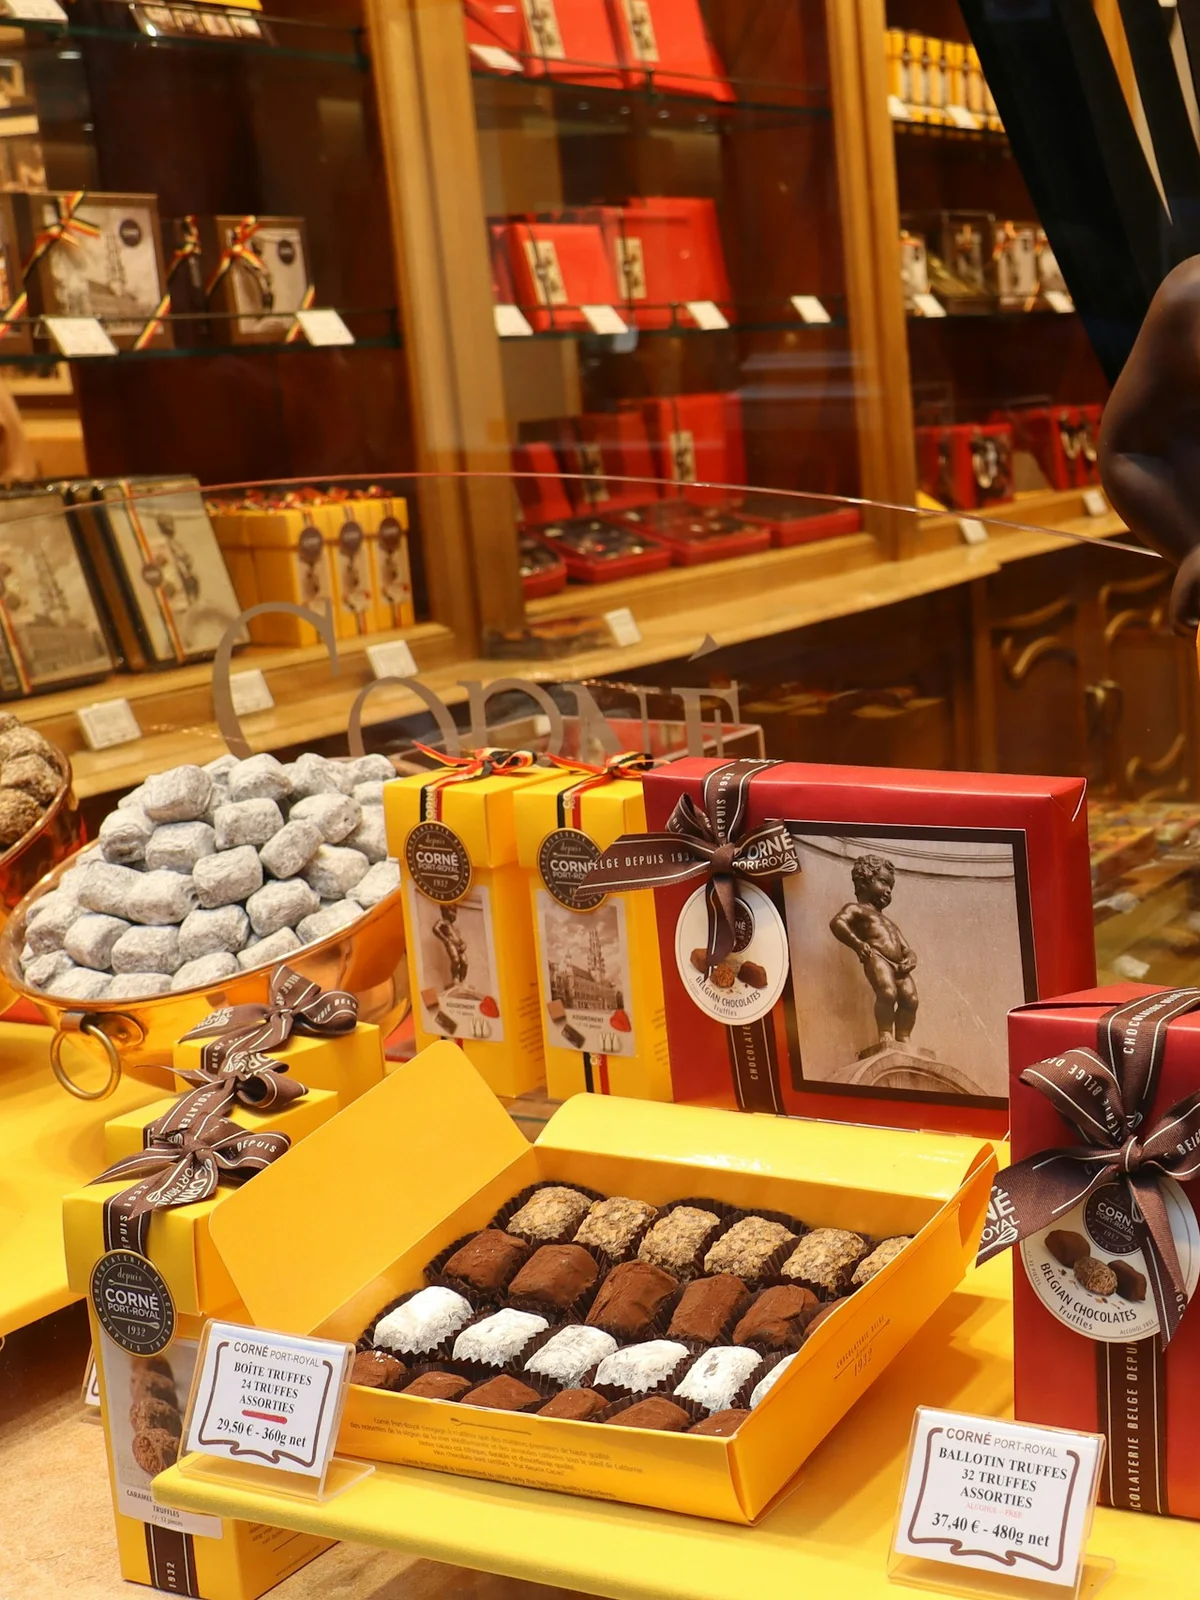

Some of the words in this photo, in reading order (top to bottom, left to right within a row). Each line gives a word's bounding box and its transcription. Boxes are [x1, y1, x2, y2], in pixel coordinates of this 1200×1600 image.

[718, 772, 735, 792] 1932
[717, 799, 726, 838] DEPUIS
[415, 851, 459, 866] CORNÉ
[418, 863, 460, 874] PORT-ROYAL
[594, 857, 619, 871] ELGE
[625, 854, 664, 867] DEPUIS
[552, 871, 587, 880] PORT-RO
[334, 998, 358, 1010] BELG
[695, 976, 720, 1004] BELGIAN
[722, 990, 761, 1008] CHOCOLATES
[742, 1026, 759, 1080] CHOCOLATE
[236, 1140, 278, 1153] DEPUIS
[124, 1185, 149, 1207] 1932
[1096, 1211, 1135, 1236] PORT-ROYAL
[1097, 1202, 1132, 1227] CORN
[119, 1215, 132, 1249] EPUIS
[117, 1267, 143, 1285] depuis
[105, 1288, 160, 1311] CORNÉ
[1040, 1262, 1073, 1306] BELGIAN
[1073, 1301, 1137, 1324] CHOCOLATES
[107, 1302, 161, 1320] PORT-ROYAL
[1058, 1304, 1094, 1330] Truffles
[127, 1324, 146, 1337] 1932
[233, 1341, 270, 1358] CORNÉ
[270, 1350, 320, 1368] PORT-ROYAL
[1126, 1341, 1138, 1381] DEPU
[234, 1361, 265, 1377] BOÎTE
[268, 1370, 313, 1387] TRUFFES
[241, 1379, 252, 1390] 24
[254, 1381, 299, 1400] TRUFFES
[239, 1395, 295, 1414] ASSORTIES
[1126, 1388, 1139, 1430] BELGE
[217, 1418, 244, 1435] 29,50
[246, 1424, 254, 1437] €
[262, 1427, 287, 1446] 360g
[289, 1434, 307, 1448] net
[946, 1427, 992, 1446] CORNÉ
[993, 1437, 1058, 1458] PORT-ROYAL
[939, 1447, 1005, 1468] BALLOTIN
[1008, 1459, 1068, 1480] TRUFFES
[1127, 1437, 1141, 1511] COLATERIE
[961, 1468, 975, 1481] 32
[979, 1471, 1037, 1492] TRUFFES
[126, 1489, 152, 1502] CARAMEL
[960, 1486, 1033, 1509] ASSORTIES
[152, 1505, 180, 1518] TRUFFLES
[965, 1502, 998, 1515] ALCOHOL
[1004, 1508, 1023, 1519] FREE
[931, 1512, 968, 1531] 37,40
[971, 1519, 980, 1534] €
[992, 1524, 1024, 1546] 480g
[1028, 1533, 1050, 1548] net
[166, 1562, 177, 1588] 1932
